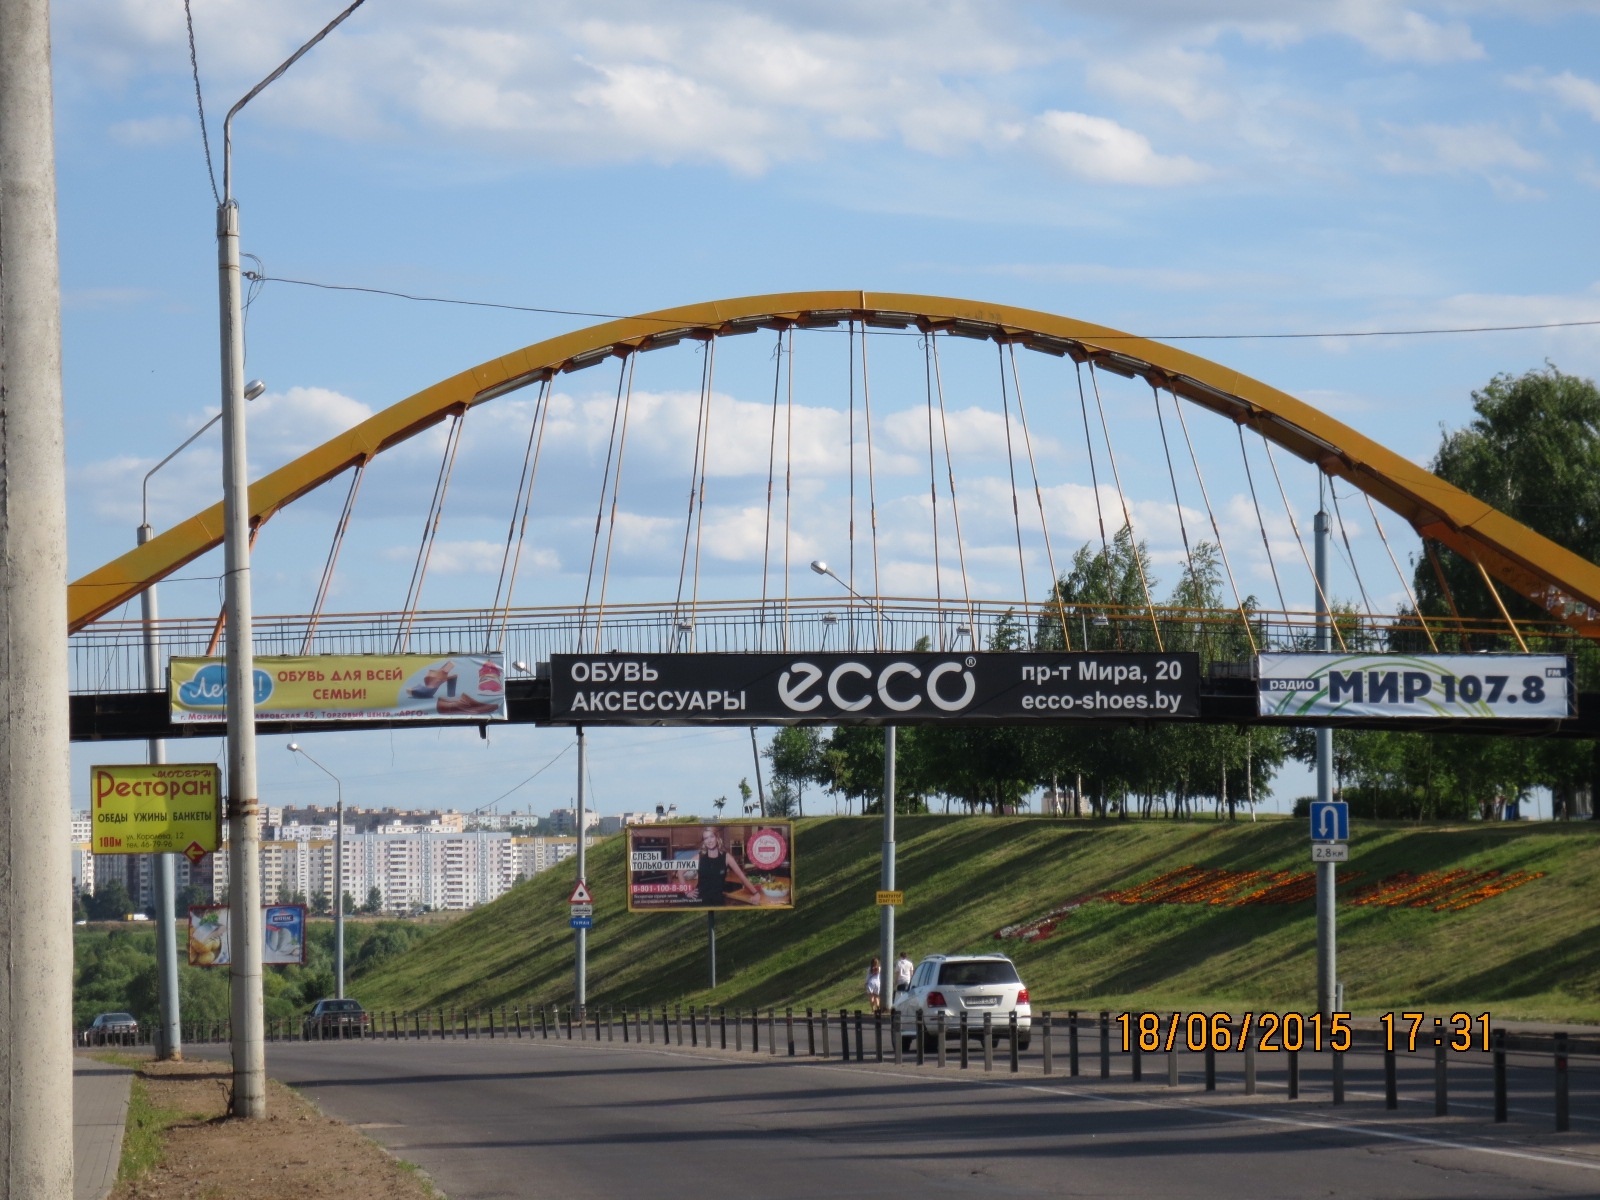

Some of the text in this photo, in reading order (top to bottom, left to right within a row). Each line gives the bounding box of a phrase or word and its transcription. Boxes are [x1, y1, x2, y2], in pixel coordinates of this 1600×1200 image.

[278, 667, 403, 682] ОБУВЬ ДЛЯ ВСЕЙ
[571, 661, 659, 682] ОБУВЬ
[1022, 660, 1182, 686] пр-т Мира, 20
[1547, 668, 1562, 677] FM
[313, 688, 367, 700] СЕМЬИ!
[778, 661, 976, 712] ecco
[1269, 670, 1546, 704] радио МИР 107.8
[570, 690, 746, 712] АКСЕССУАРЫ
[1021, 690, 1182, 714] ecco-shoes.by
[97, 770, 212, 808] Ресторан
[97, 810, 212, 824] ОБЕДЫ УЖИНЫ БАНКЕТЫ
[175, 831, 185, 840] 12
[140, 839, 173, 849] 46-79-96
[632, 852, 659, 861] СЛЕЗЫ
[633, 860, 697, 870] ТОЛЬКО ОТ ЛУКА
